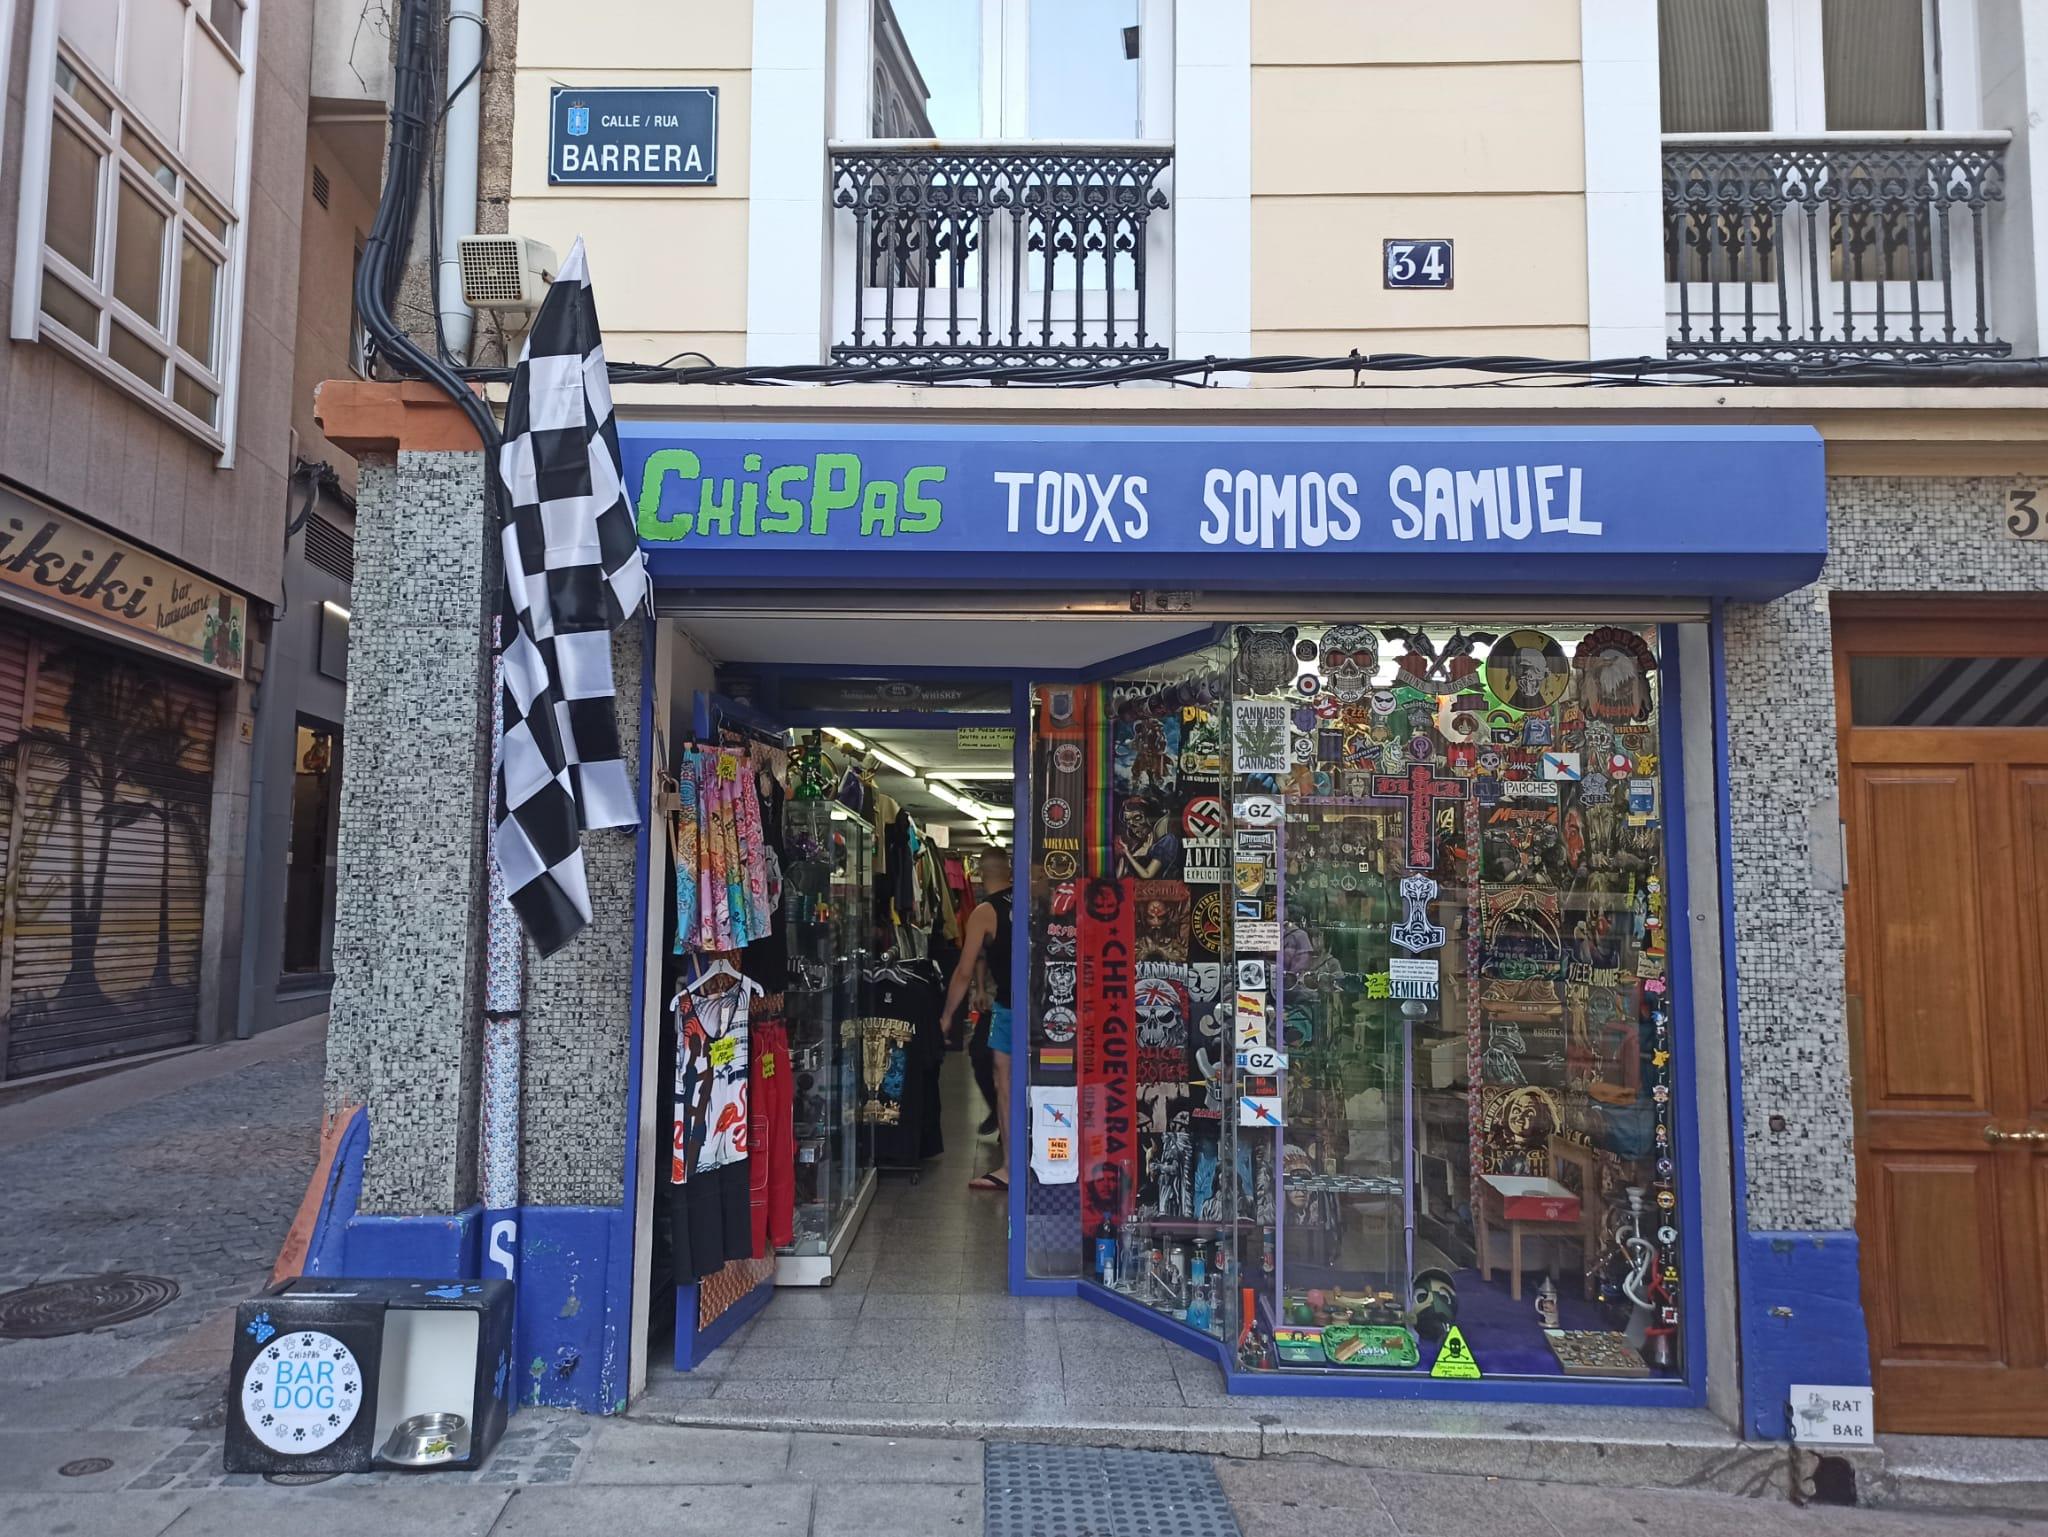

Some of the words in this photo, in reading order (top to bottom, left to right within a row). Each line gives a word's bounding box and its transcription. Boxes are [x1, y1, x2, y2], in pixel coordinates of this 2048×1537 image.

[601, 115, 640, 127] CALLE
[645, 115, 650, 127] /
[654, 115, 679, 127] RUA
[562, 144, 703, 172] BARRERA
[1392, 245, 1444, 280] 34
[994, 470, 1149, 543] TODXS
[1200, 468, 1361, 549] SOMOS
[1389, 465, 1602, 542] SAMUEL
[2007, 490, 2048, 538] 3
[171, 578, 192, 604] bar
[1236, 706, 1286, 720] CANNABIS
[1615, 725, 1649, 734] NIRVANA
[1238, 756, 1286, 770] CANNABIS
[1506, 782, 1557, 795] PARCHES
[1580, 793, 1611, 807] QUEEN
[1248, 804, 1272, 817] GZ
[1043, 837, 1079, 850] NIRVANA
[1186, 868, 1219, 881] EXPLICIT
[1083, 954, 1095, 988] HASTA
[1102, 940, 1129, 1000] CHE
[1390, 981, 1438, 999] SEMILLAS
[1083, 1000, 1095, 1013] LA
[1083, 1024, 1095, 1075] VICTORIA
[1250, 1053, 1274, 1068] GZ
[1102, 1016, 1129, 1153] GUEVARA
[275, 1361, 335, 1385] BAR
[273, 1385, 335, 1409] DOG
[1832, 1400, 1862, 1412] RAT
[1832, 1424, 1863, 1437] BAR
